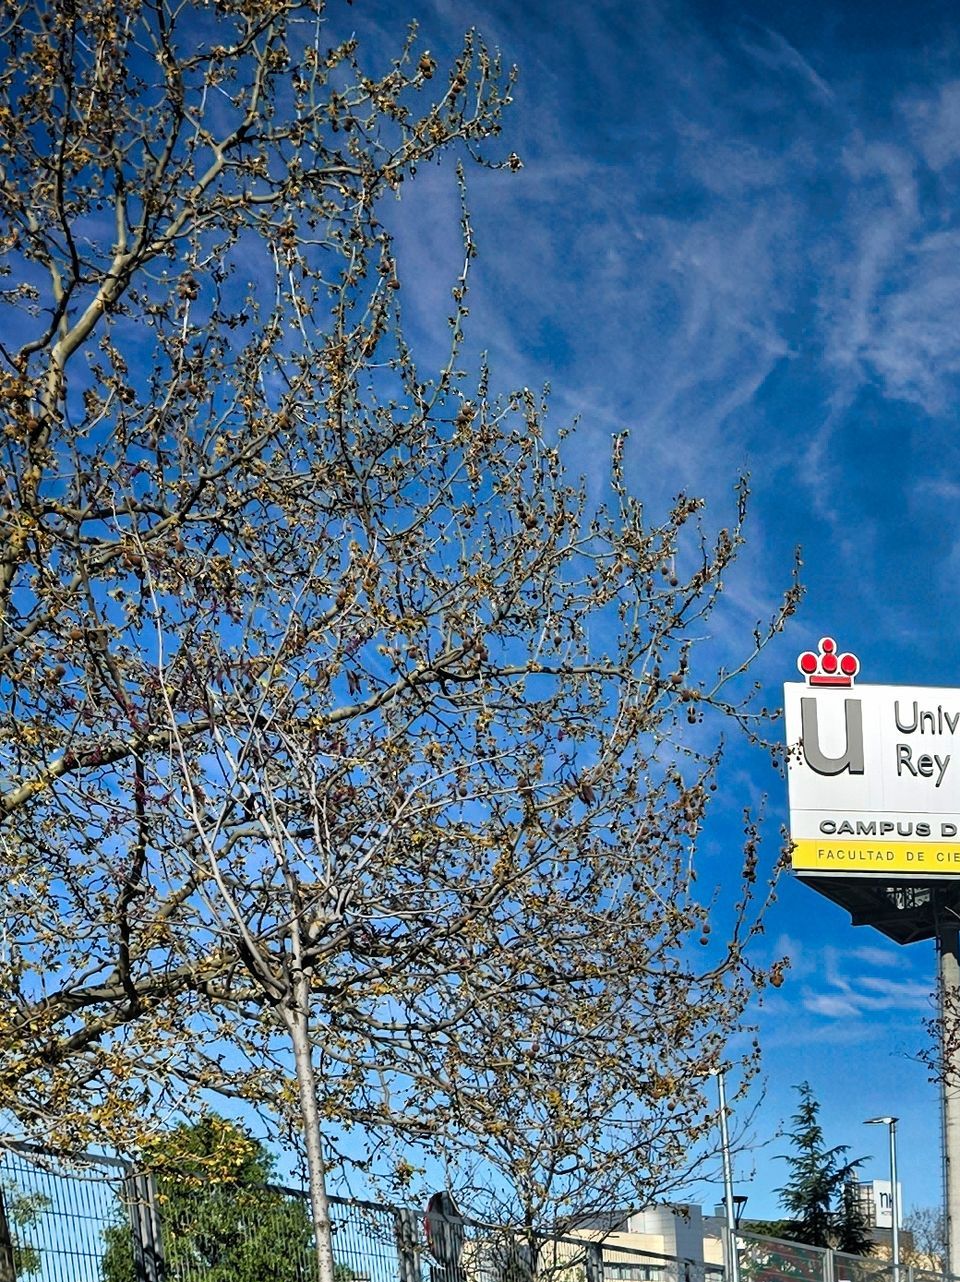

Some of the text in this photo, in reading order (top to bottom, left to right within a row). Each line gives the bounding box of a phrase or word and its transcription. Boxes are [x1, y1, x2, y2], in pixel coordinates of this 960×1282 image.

[896, 743, 951, 788] Rey
[819, 819, 931, 837] CAMPUS
[818, 849, 895, 861] FACULTAD
[906, 851, 925, 862] DE
